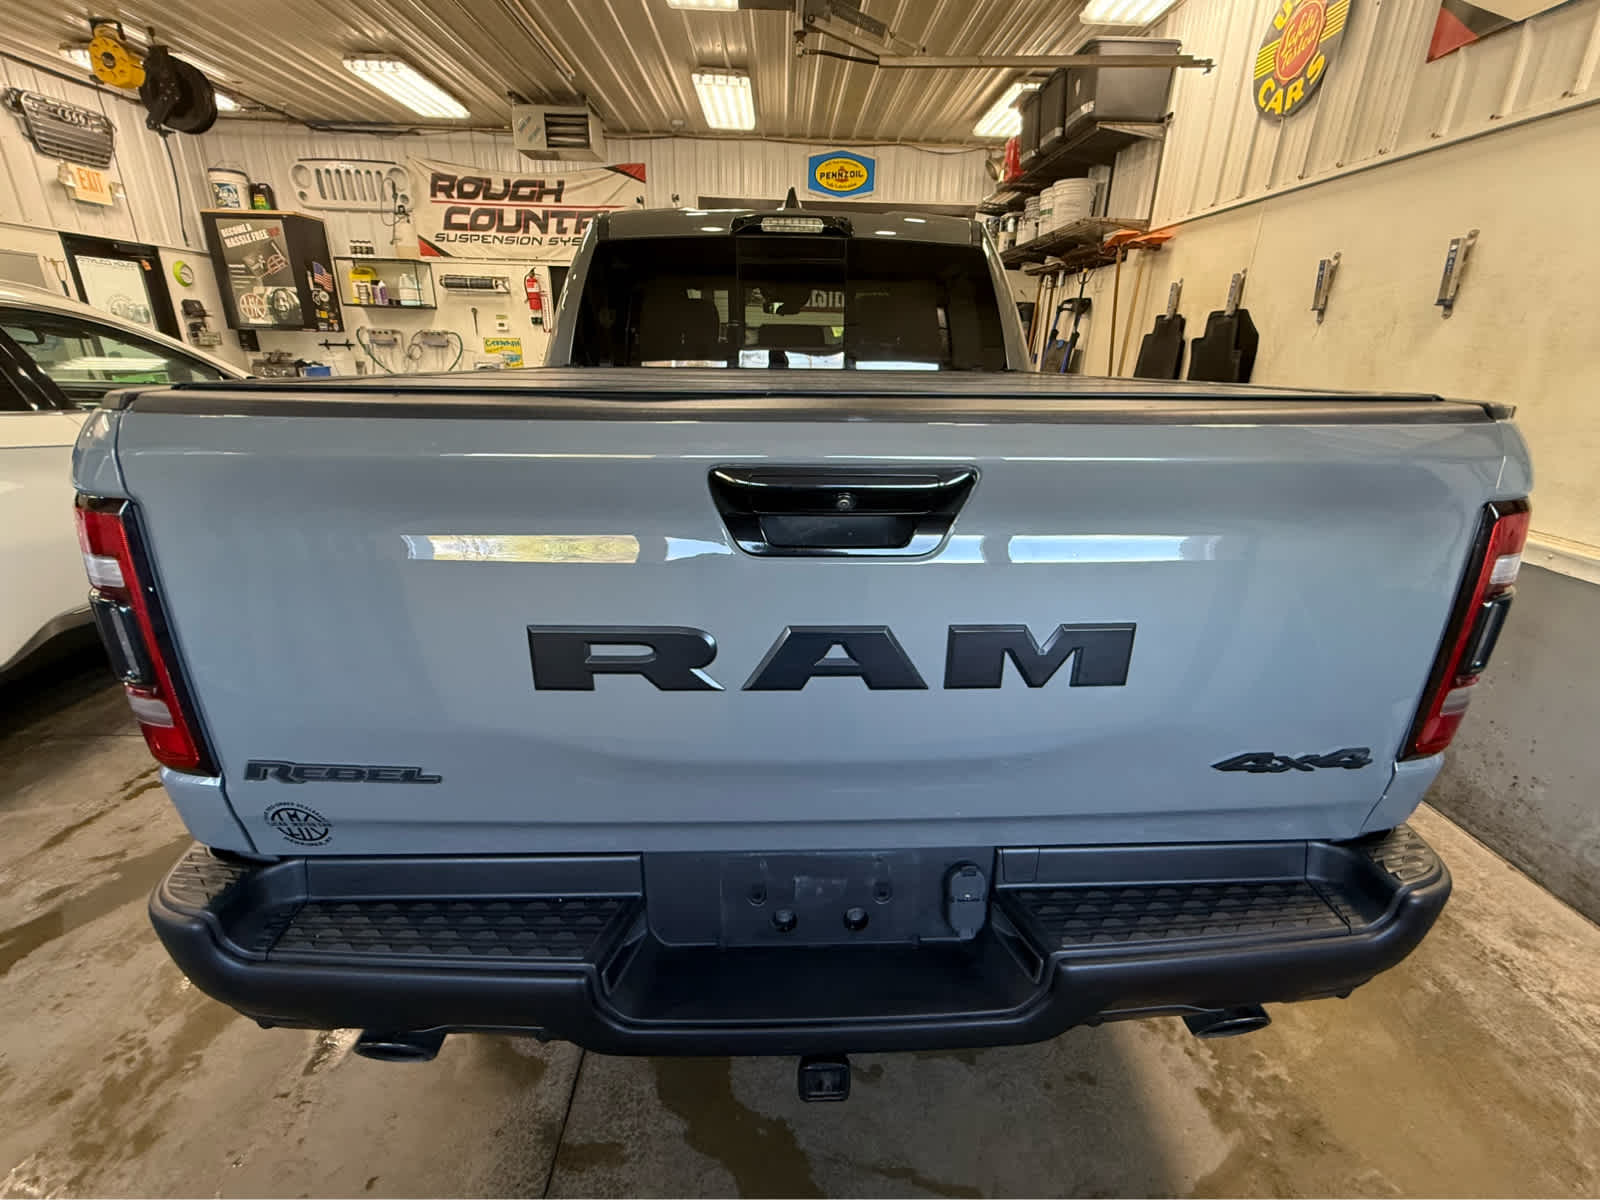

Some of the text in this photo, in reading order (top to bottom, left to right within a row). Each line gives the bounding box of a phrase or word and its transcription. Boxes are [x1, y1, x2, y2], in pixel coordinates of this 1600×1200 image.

[1258, 51, 1325, 114] CARS
[76, 167, 104, 193] EXIT
[430, 173, 565, 203] ROUGH
[819, 170, 864, 181] PENNZOIL
[435, 233, 583, 246] SUSPENSION SYS
[526, 622, 1137, 691] RAM
[244, 760, 442, 784] REBEL
